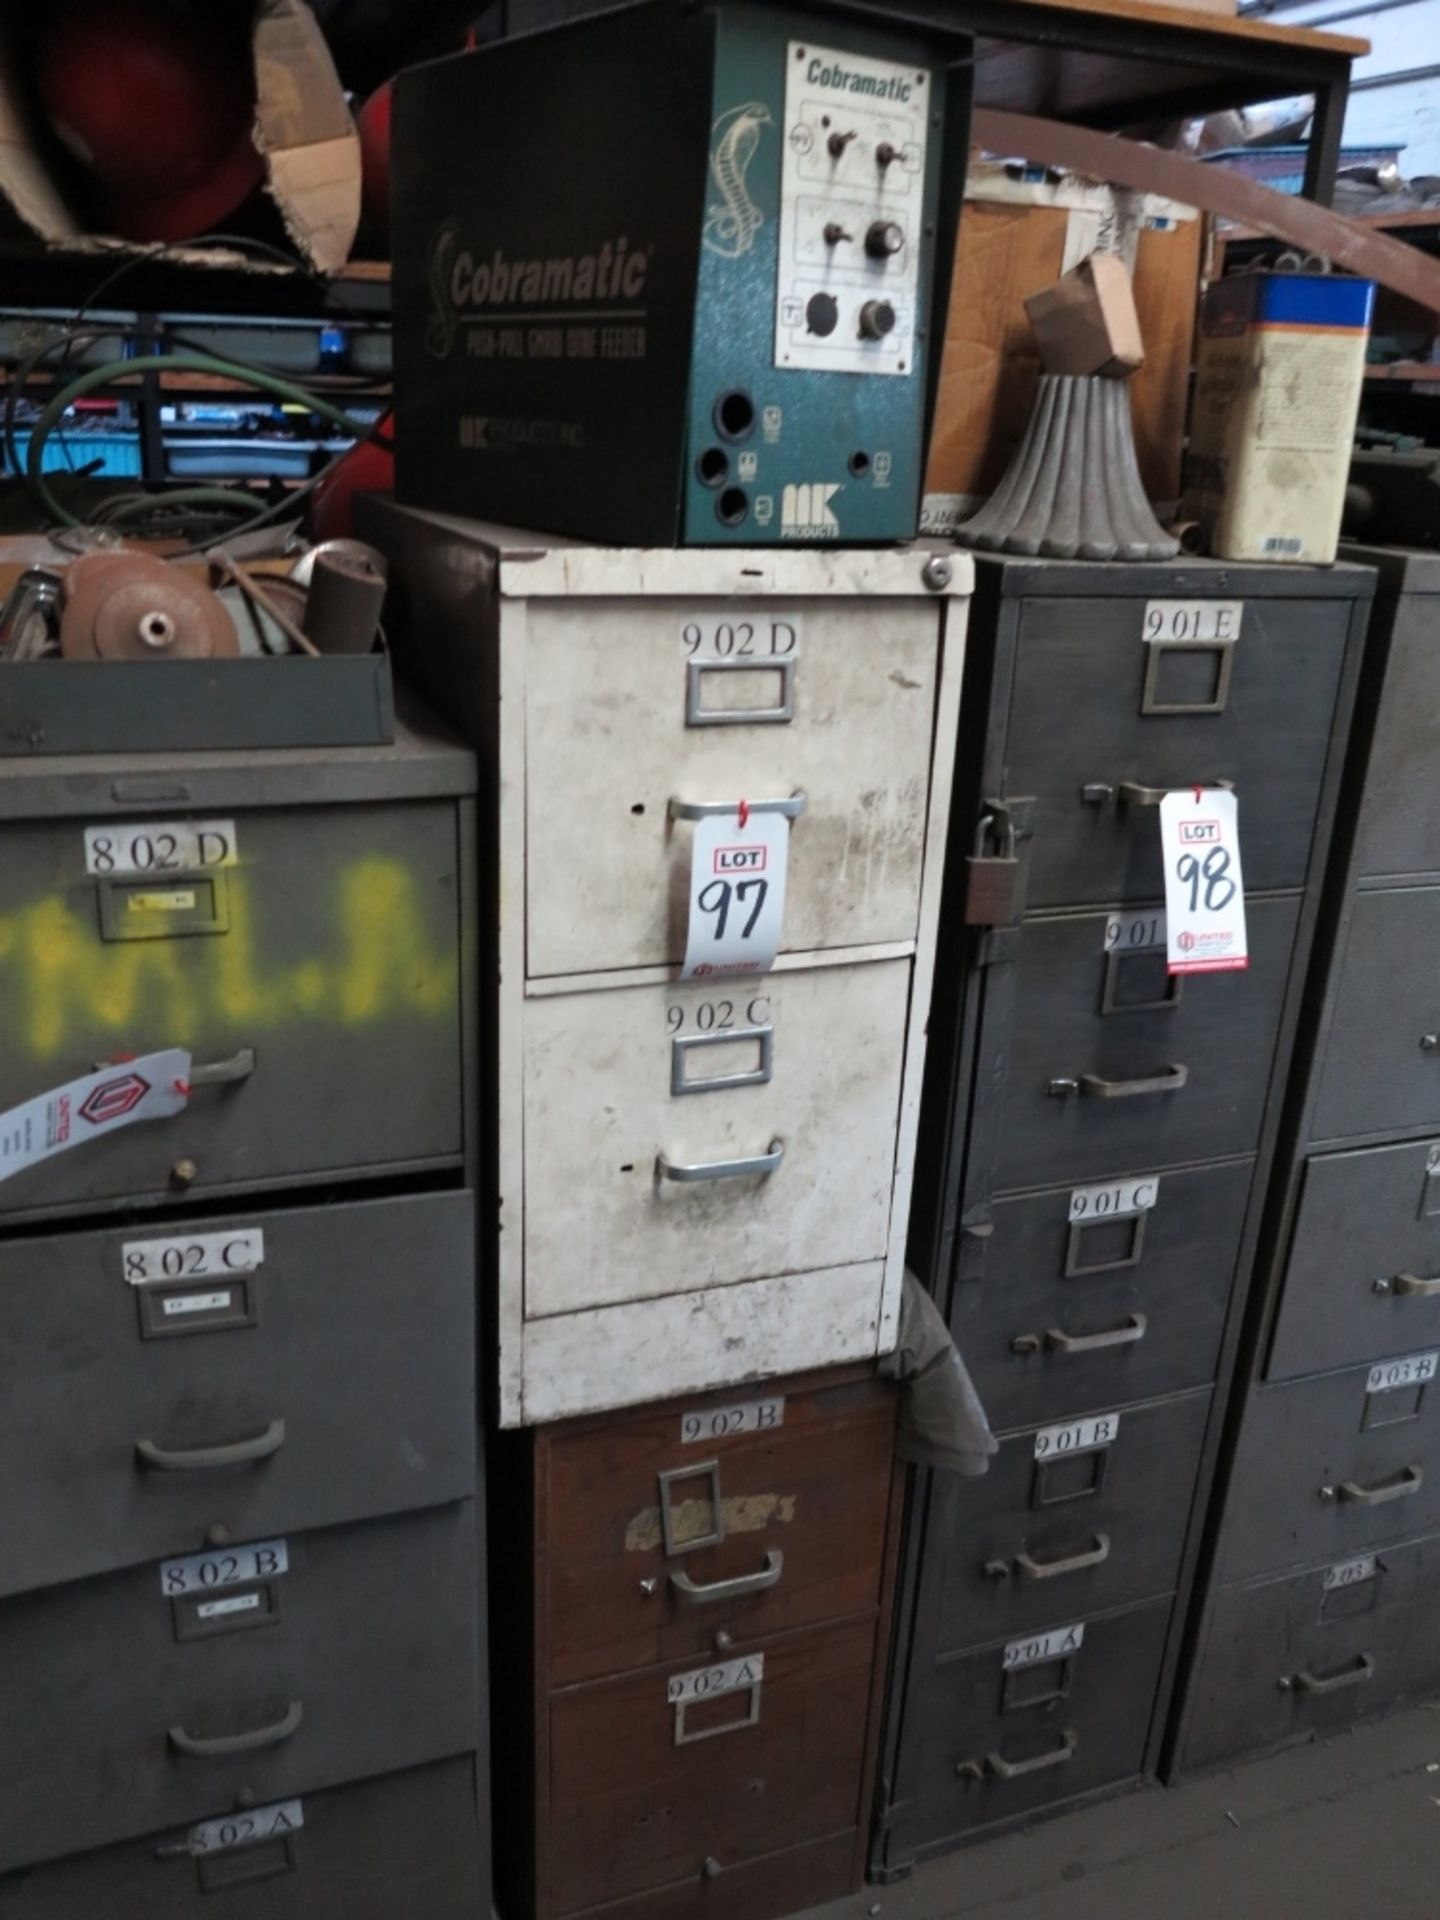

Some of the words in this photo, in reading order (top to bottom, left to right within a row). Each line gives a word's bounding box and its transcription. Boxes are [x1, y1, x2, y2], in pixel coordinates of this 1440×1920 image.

[807, 58, 912, 103] Cobramatic
[452, 236, 648, 305] Cobramatic
[601, 327, 647, 357] FEEDER
[781, 483, 841, 525] MK
[780, 525, 840, 540] PRODUCTS
[1214, 609, 1233, 638] E
[769, 622, 796, 655] D
[1184, 825, 1215, 839] LOT
[197, 832, 229, 865] D
[720, 851, 760, 868] LOT
[1177, 846, 1237, 912] 98
[698, 878, 768, 940] 97
[746, 996, 770, 1025] C
[1132, 1184, 1152, 1208] C
[222, 1239, 250, 1269] C
[757, 1405, 776, 1428] B
[1093, 1421, 1109, 1442] B
[254, 1548, 278, 1575] B
